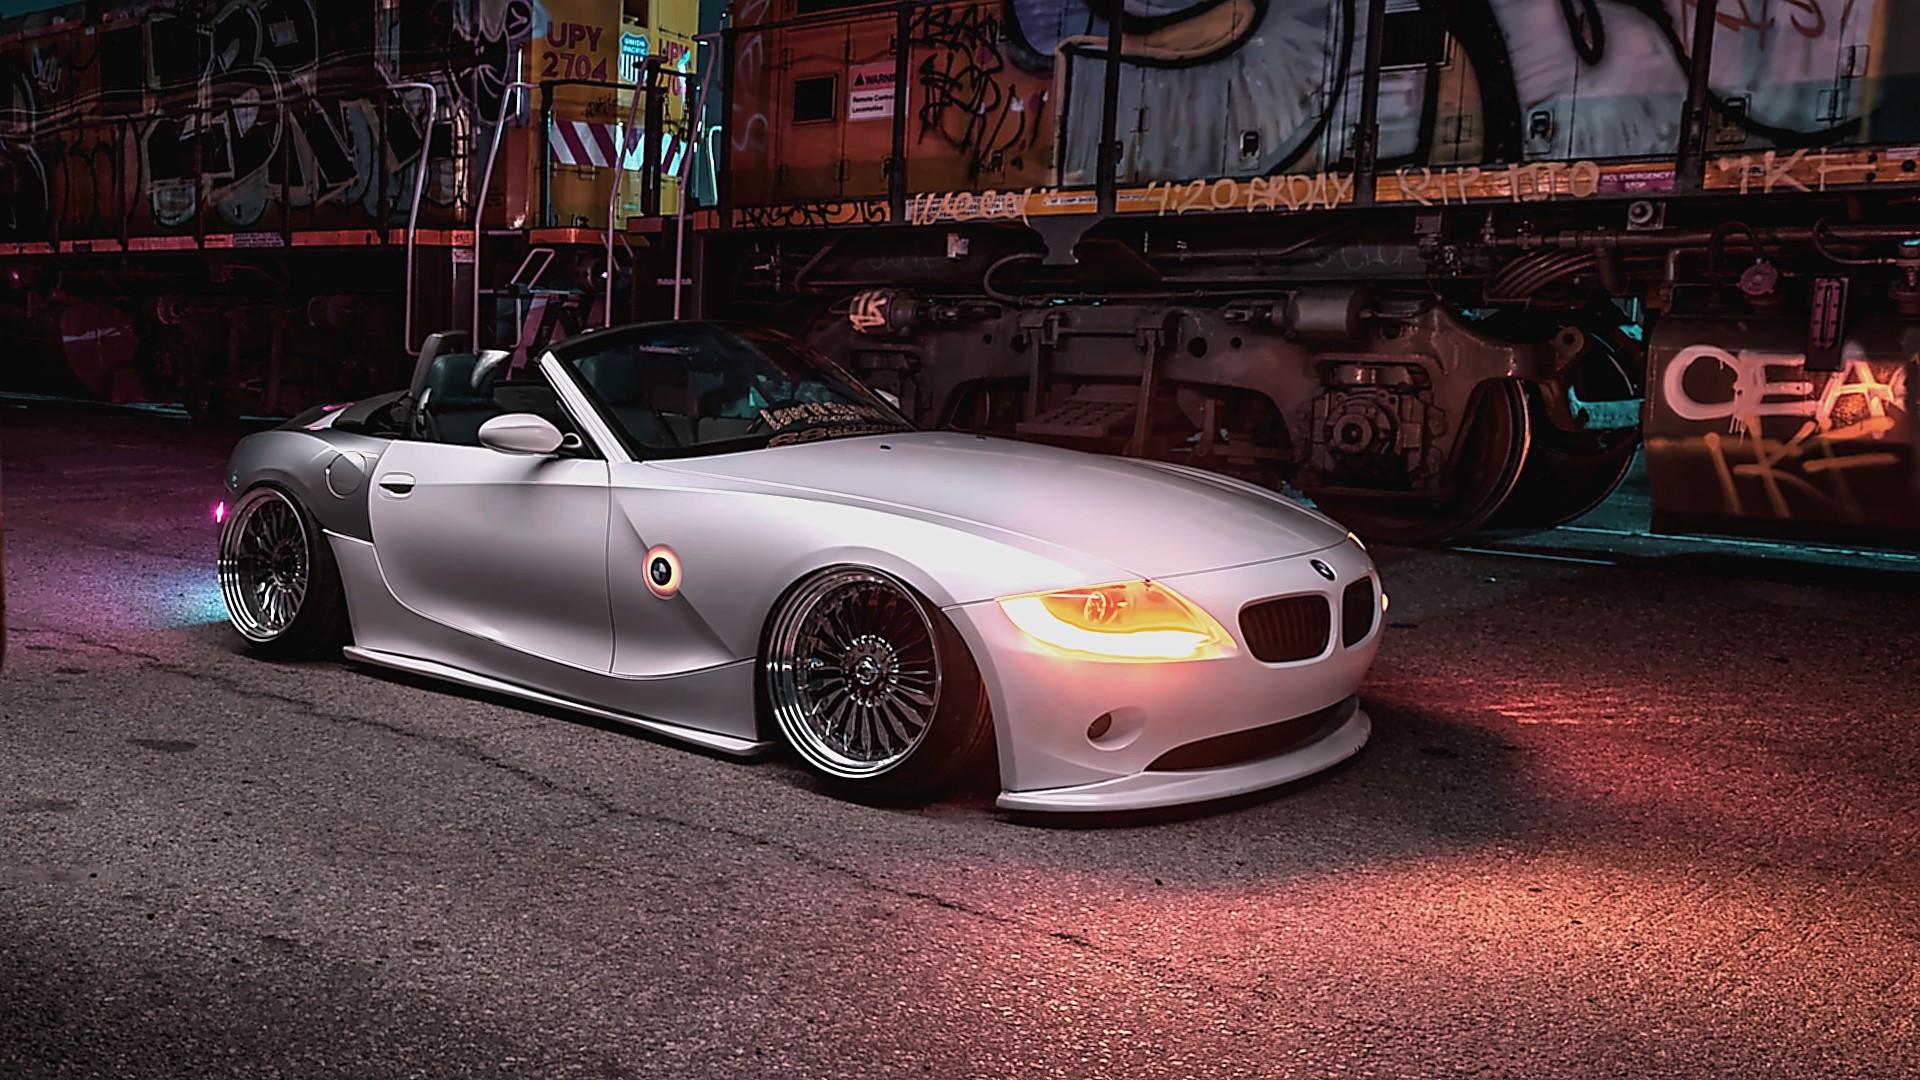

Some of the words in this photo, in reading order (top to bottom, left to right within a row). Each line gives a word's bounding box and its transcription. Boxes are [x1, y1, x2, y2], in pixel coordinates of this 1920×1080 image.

[547, 22, 603, 51] UPY
[624, 38, 646, 48] UNION
[622, 46, 648, 56] PACIFIC
[541, 51, 608, 82] 2704
[1619, 171, 1671, 181] EMERGENCY
[1396, 166, 1481, 206] RIP
[1624, 182, 1647, 190] STOP
[1142, 178, 1240, 216] 4:20
